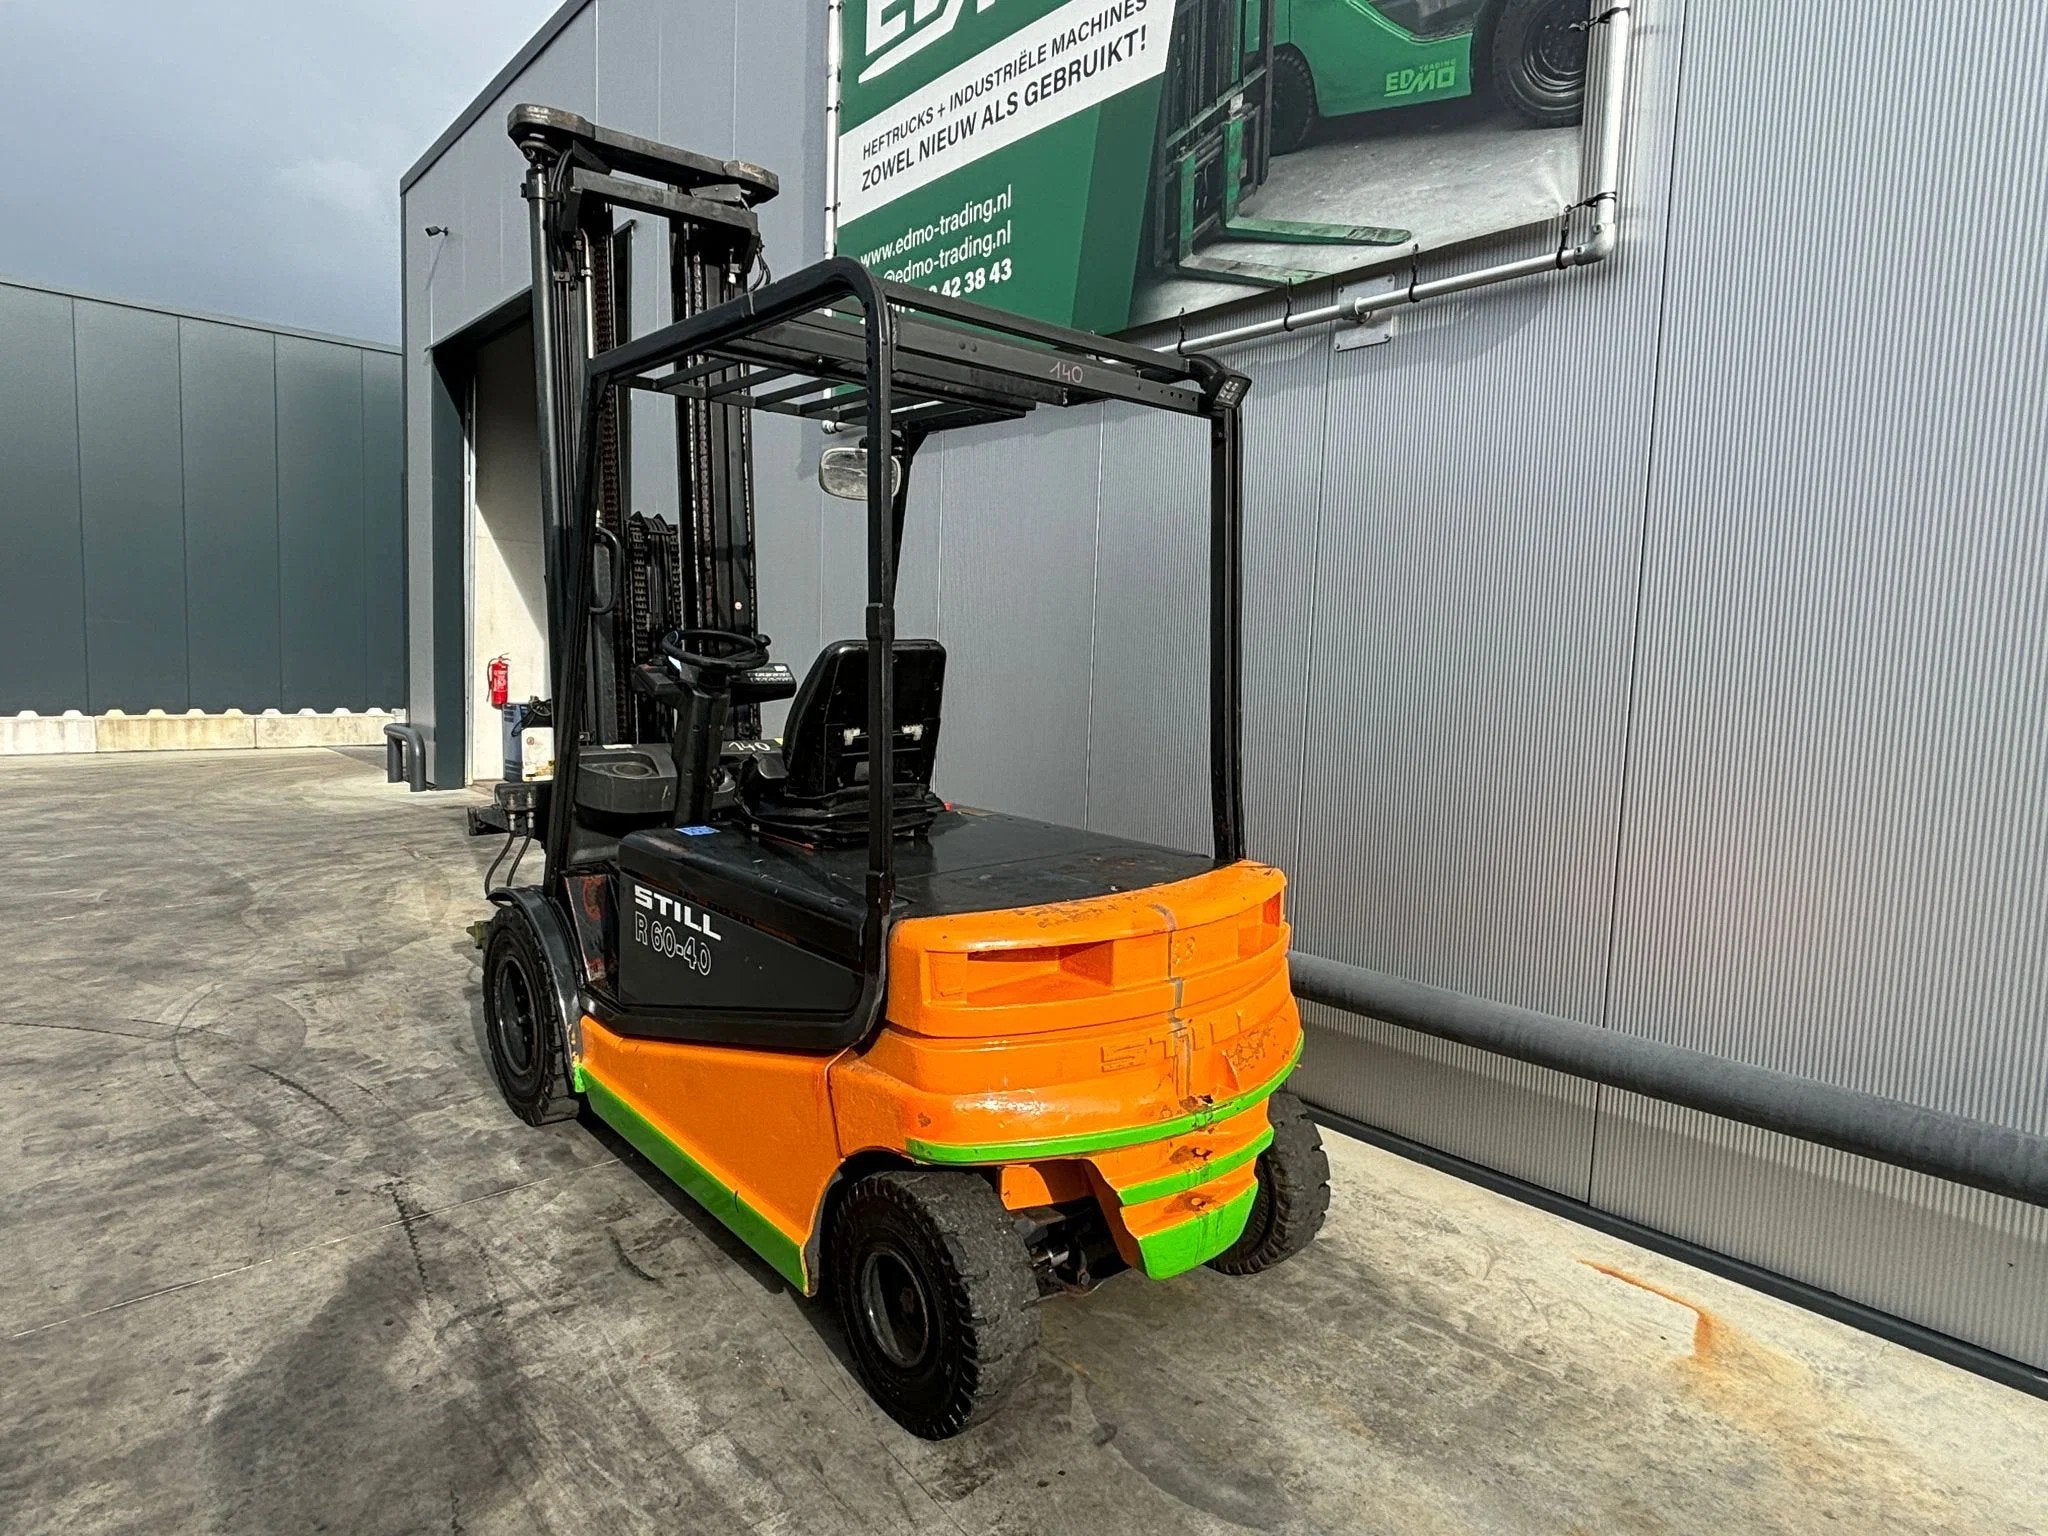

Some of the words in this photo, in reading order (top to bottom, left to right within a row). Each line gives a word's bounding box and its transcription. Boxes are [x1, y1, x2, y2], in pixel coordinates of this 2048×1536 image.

[861, 147, 915, 192] ZOWEL
[918, 111, 978, 162] NIEUW
[981, 91, 1019, 131] ALS
[1024, 24, 1147, 107] GEBRUIKT!
[862, 106, 934, 161] HEFTRUCKS
[937, 103, 946, 118] +
[949, 43, 1047, 113] INDUSTRIËLE
[1051, 0, 1148, 58] MACHINES
[1383, 66, 1456, 97] EDMO
[859, 183, 1013, 269] www.edmo-trading.nl
[941, 276, 962, 299] 42
[964, 267, 987, 294] 38
[989, 257, 1013, 284] 43
[1050, 360, 1085, 385] 140
[634, 884, 722, 942] STILL
[634, 910, 649, 946] R
[650, 920, 712, 976] 60-40
